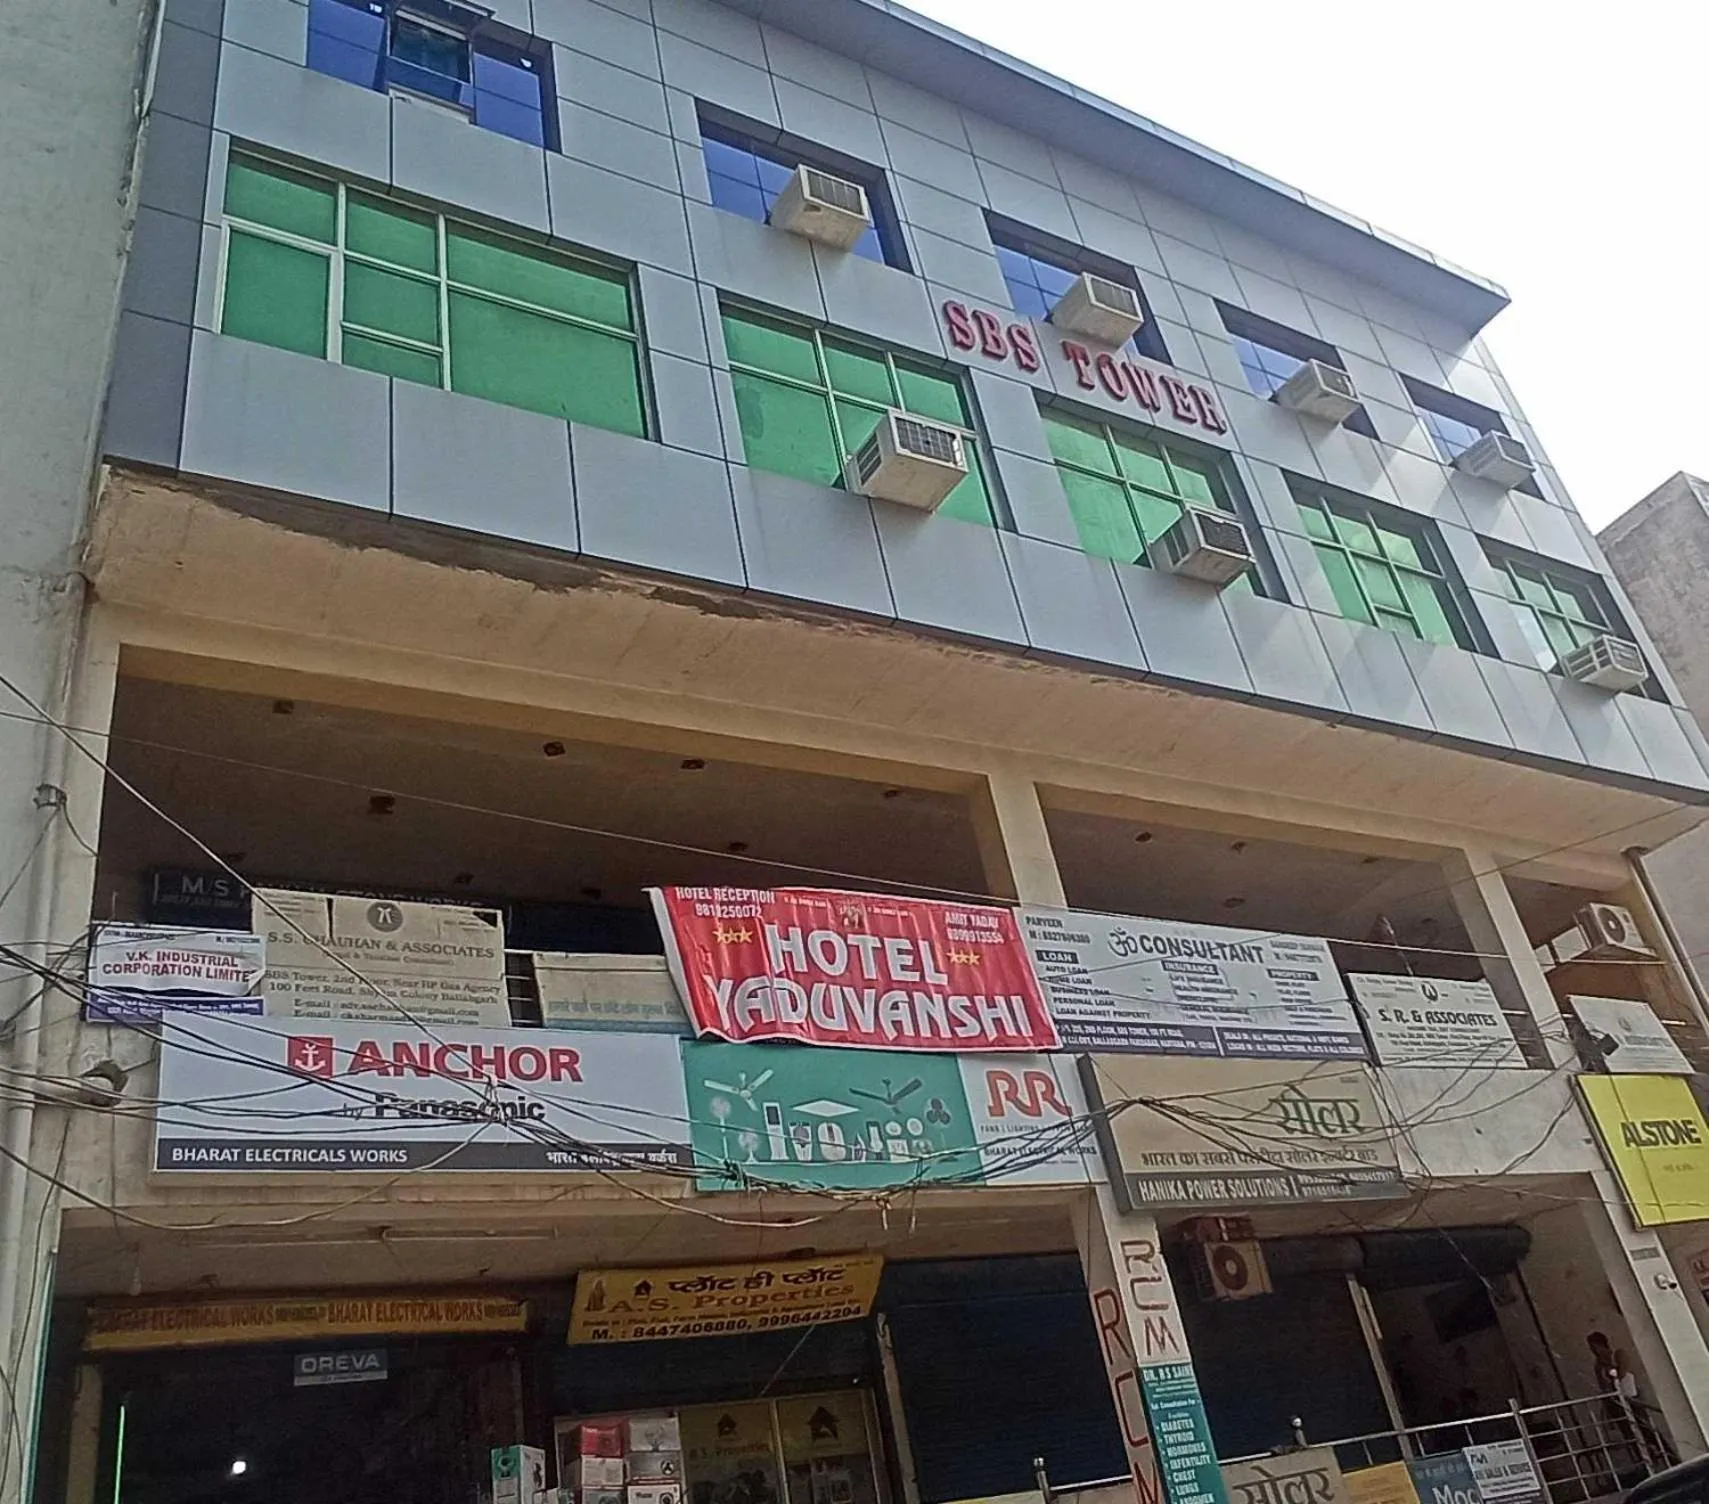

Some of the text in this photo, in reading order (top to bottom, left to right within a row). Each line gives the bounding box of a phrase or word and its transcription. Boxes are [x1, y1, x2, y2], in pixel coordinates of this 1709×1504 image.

[943, 300, 1227, 435] SBS TOWER
[675, 887, 712, 900] HOTEL
[713, 887, 776, 903] RECEPTION
[267, 931, 298, 944] S.S.
[302, 933, 381, 950] CHAUHAN
[386, 939, 399, 951] &
[401, 942, 495, 959] ASSOCIATES
[764, 923, 948, 986] HOTEL
[1139, 934, 1264, 963] CONSULTANT
[157, 951, 239, 967] INDUSTRIAL
[102, 963, 256, 984] CORPORATION LIMITE
[270, 982, 291, 992] 100
[703, 974, 1034, 1041] YADUVANSHI
[1412, 1011, 1423, 1022] &
[1426, 1012, 1498, 1026] ASSOCIATES
[347, 1040, 584, 1083] ANCHOR
[375, 1092, 545, 1121] Panasonic
[986, 1070, 1073, 1117] RR
[1620, 1120, 1702, 1148] ALSTONE
[172, 1147, 408, 1163] BHARAT ELECTRICALS WORKS
[1141, 1151, 1176, 1166] भारत
[1179, 1151, 1199, 1166] का
[1188, 1178, 1229, 1201] POWER
[1229, 1175, 1290, 1200] SOLUTIONS
[669, 1274, 738, 1294] प्लॉट
[782, 1267, 846, 1285] प्लॉट
[328, 1302, 373, 1324] BHARAT
[375, 1300, 442, 1323] ELECTRICAL
[444, 1299, 484, 1321] WORKS
[608, 1283, 855, 1314] A.S. Properties
[591, 1328, 614, 1339] M.
[302, 1353, 381, 1374] OREVA
[1173, 1469, 1196, 1482] CHEST
